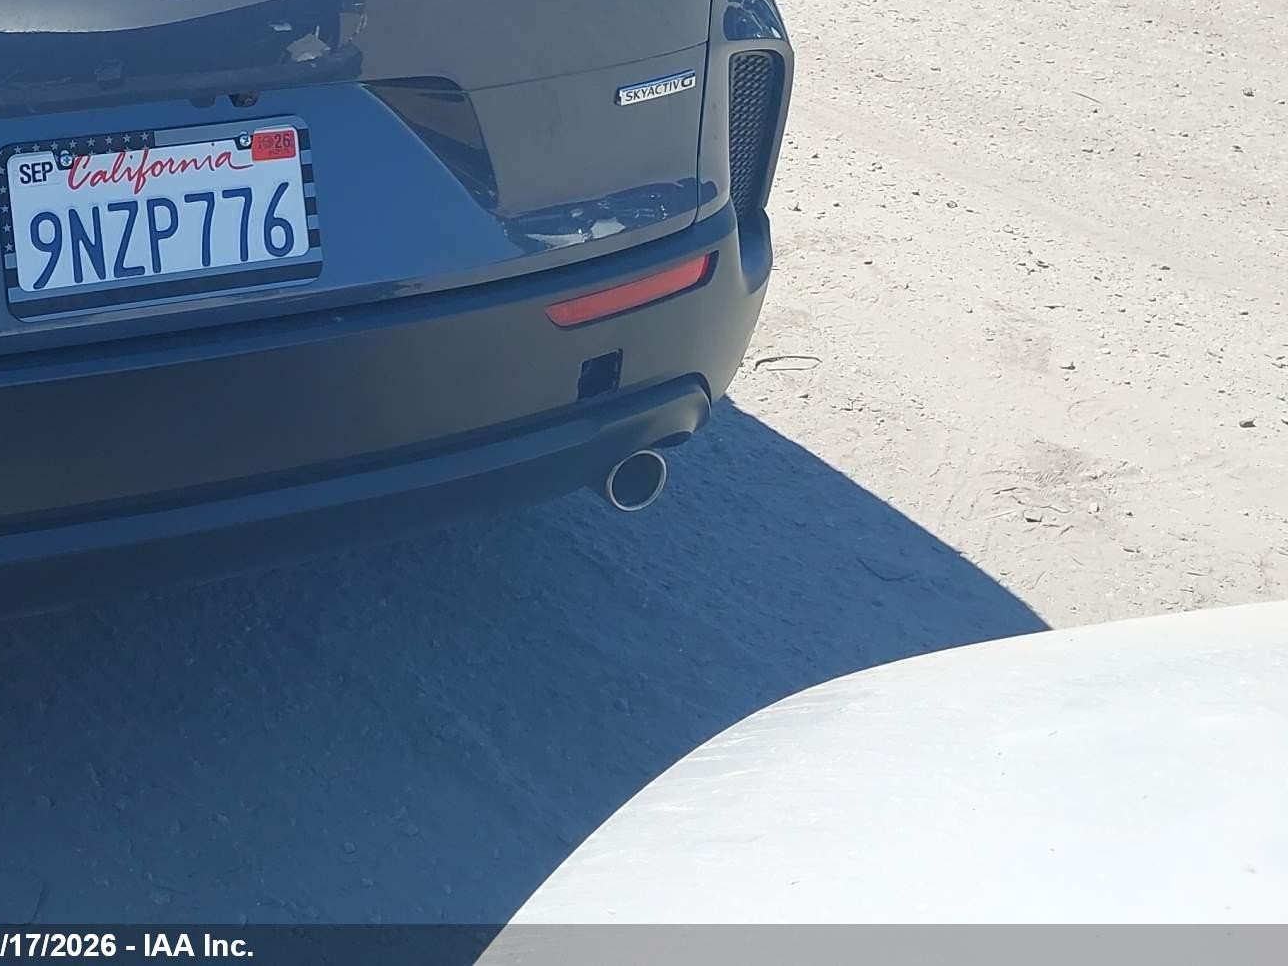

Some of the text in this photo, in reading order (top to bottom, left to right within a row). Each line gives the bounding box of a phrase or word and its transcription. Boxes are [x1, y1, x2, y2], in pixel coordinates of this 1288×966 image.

[273, 134, 291, 149] 26
[19, 160, 54, 185] SEP
[66, 146, 254, 195] California
[29, 181, 296, 290] 9NZP776
